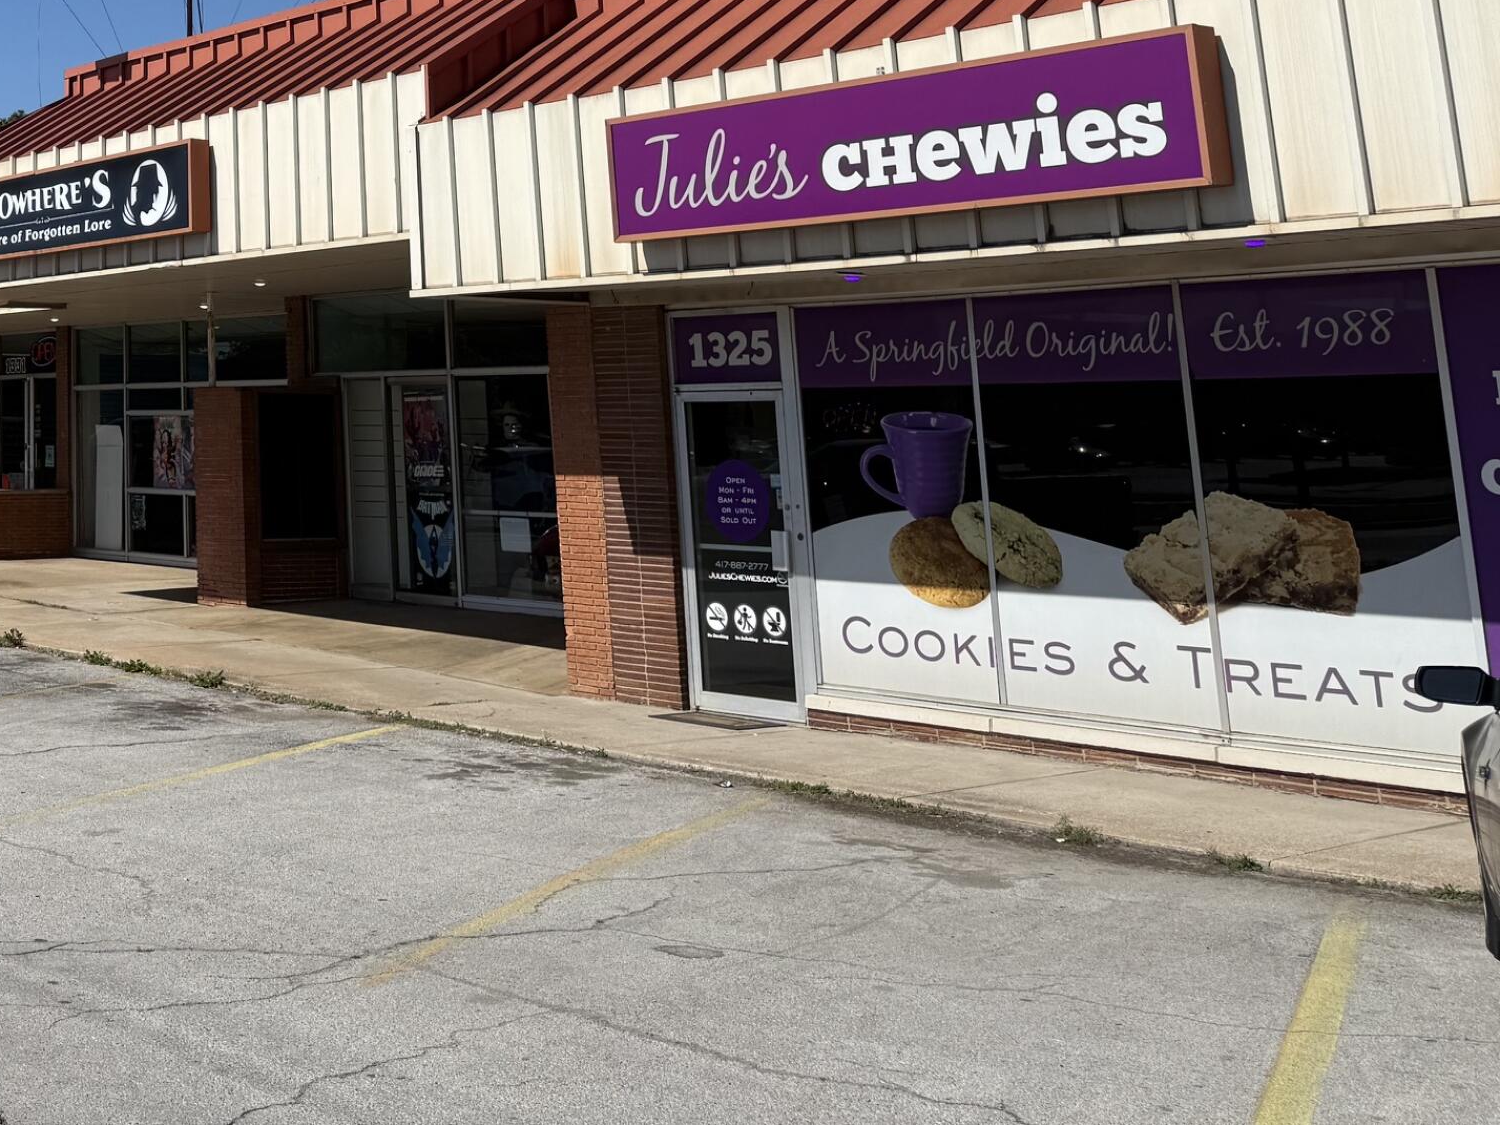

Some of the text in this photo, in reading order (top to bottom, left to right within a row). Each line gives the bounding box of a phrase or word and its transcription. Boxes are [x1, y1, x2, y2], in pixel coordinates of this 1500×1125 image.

[634, 128, 809, 218] Julie's
[11, 230, 23, 244] of
[24, 221, 81, 242] Forgotten
[84, 217, 112, 233] Lore
[815, 331, 847, 368] A
[1025, 311, 1175, 372] Original!
[1209, 308, 1395, 356] Est. 1988
[688, 329, 773, 368] 1325
[718, 486, 735, 494] MON
[725, 476, 746, 484] OPEN
[717, 496, 733, 504] 8AM
[734, 507, 755, 515] UNTIL
[720, 516, 739, 524] SOLD
[841, 615, 1076, 676] COOKIES
[1108, 641, 1150, 684] &
